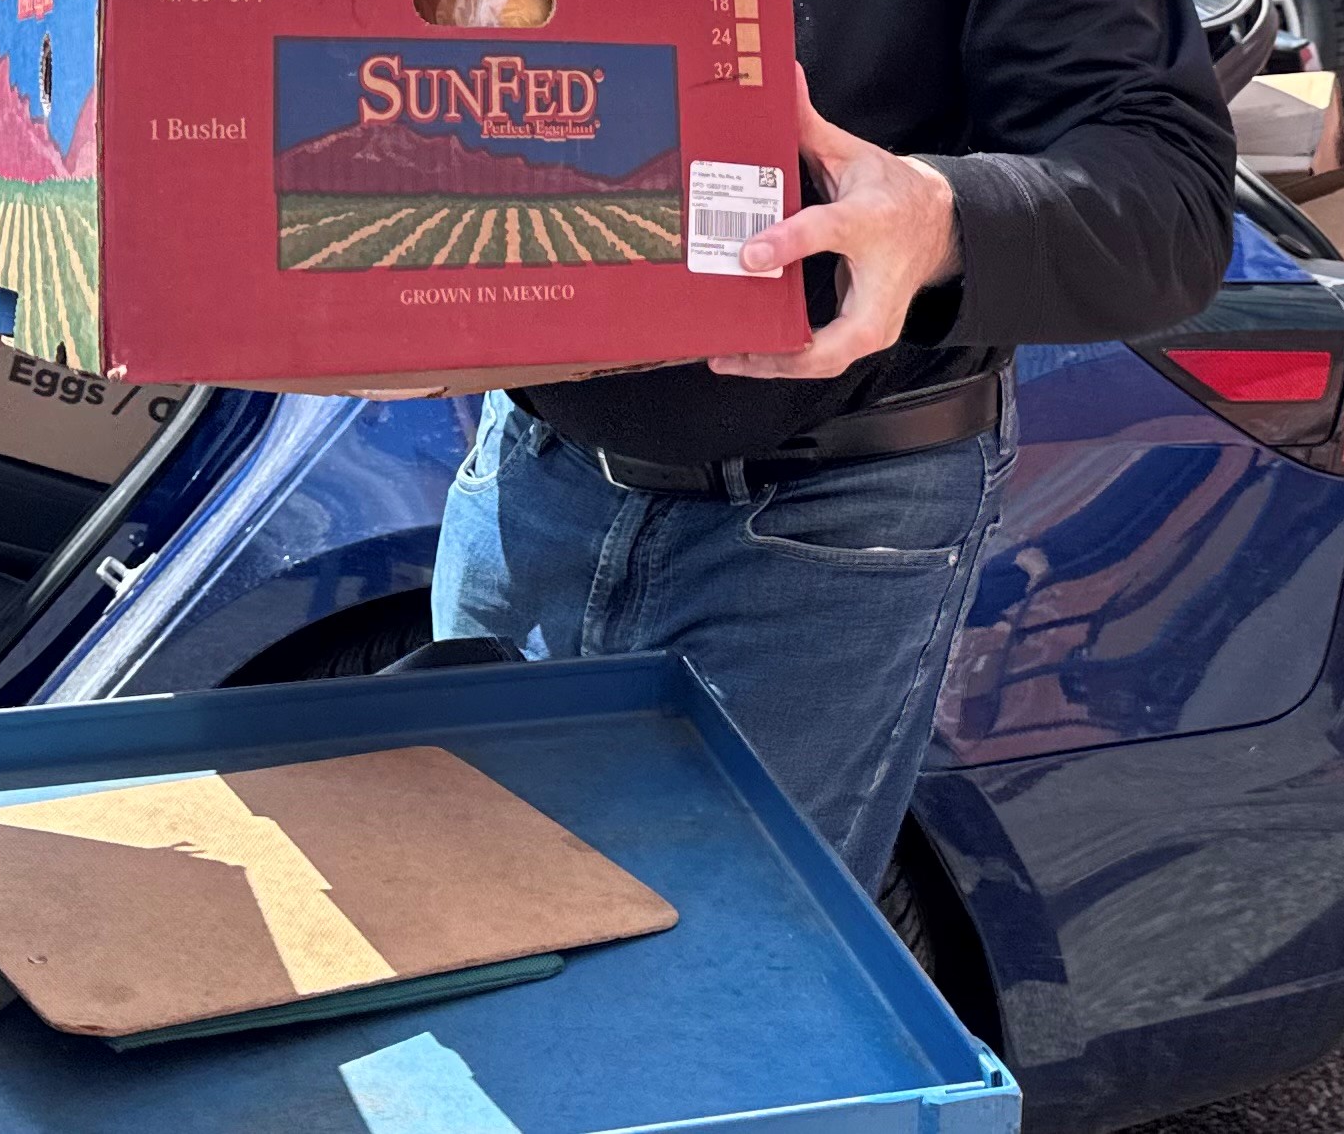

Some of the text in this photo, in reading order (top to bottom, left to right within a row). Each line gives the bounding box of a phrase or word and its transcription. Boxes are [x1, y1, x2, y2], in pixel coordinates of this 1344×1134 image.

[712, 28, 732, 45] 24
[714, 62, 733, 79] 32
[149, 116, 247, 140] 1 Bushel
[482, 120, 533, 137] Perfect
[400, 284, 575, 305] GROWN IN MEXICO
[8, 354, 105, 405] Eggs
